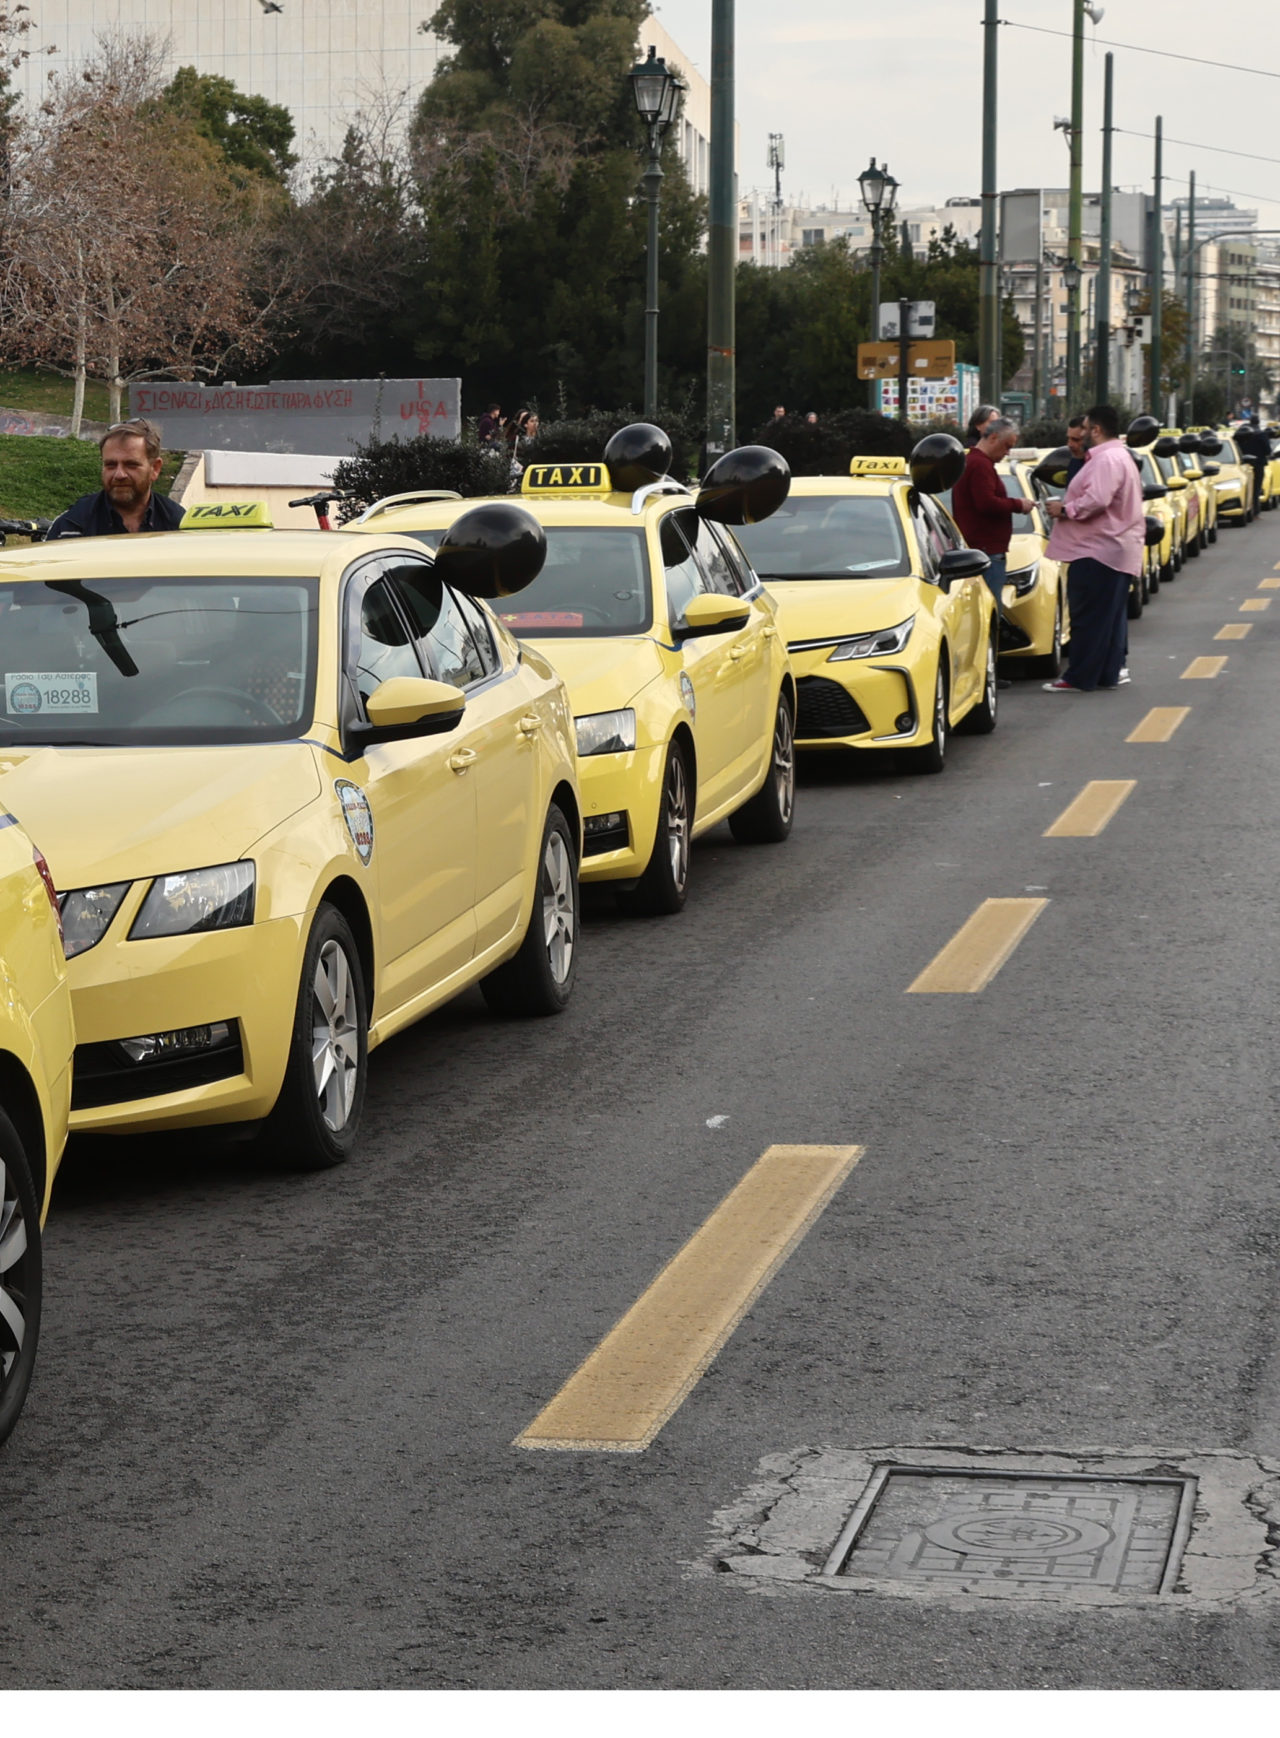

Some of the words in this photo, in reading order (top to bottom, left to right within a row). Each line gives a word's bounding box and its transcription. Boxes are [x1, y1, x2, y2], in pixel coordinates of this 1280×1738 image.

[856, 459, 899, 469] Taxi
[536, 467, 595, 485] TAXI
[192, 504, 257, 518] TAXI
[43, 690, 92, 705] 18288
